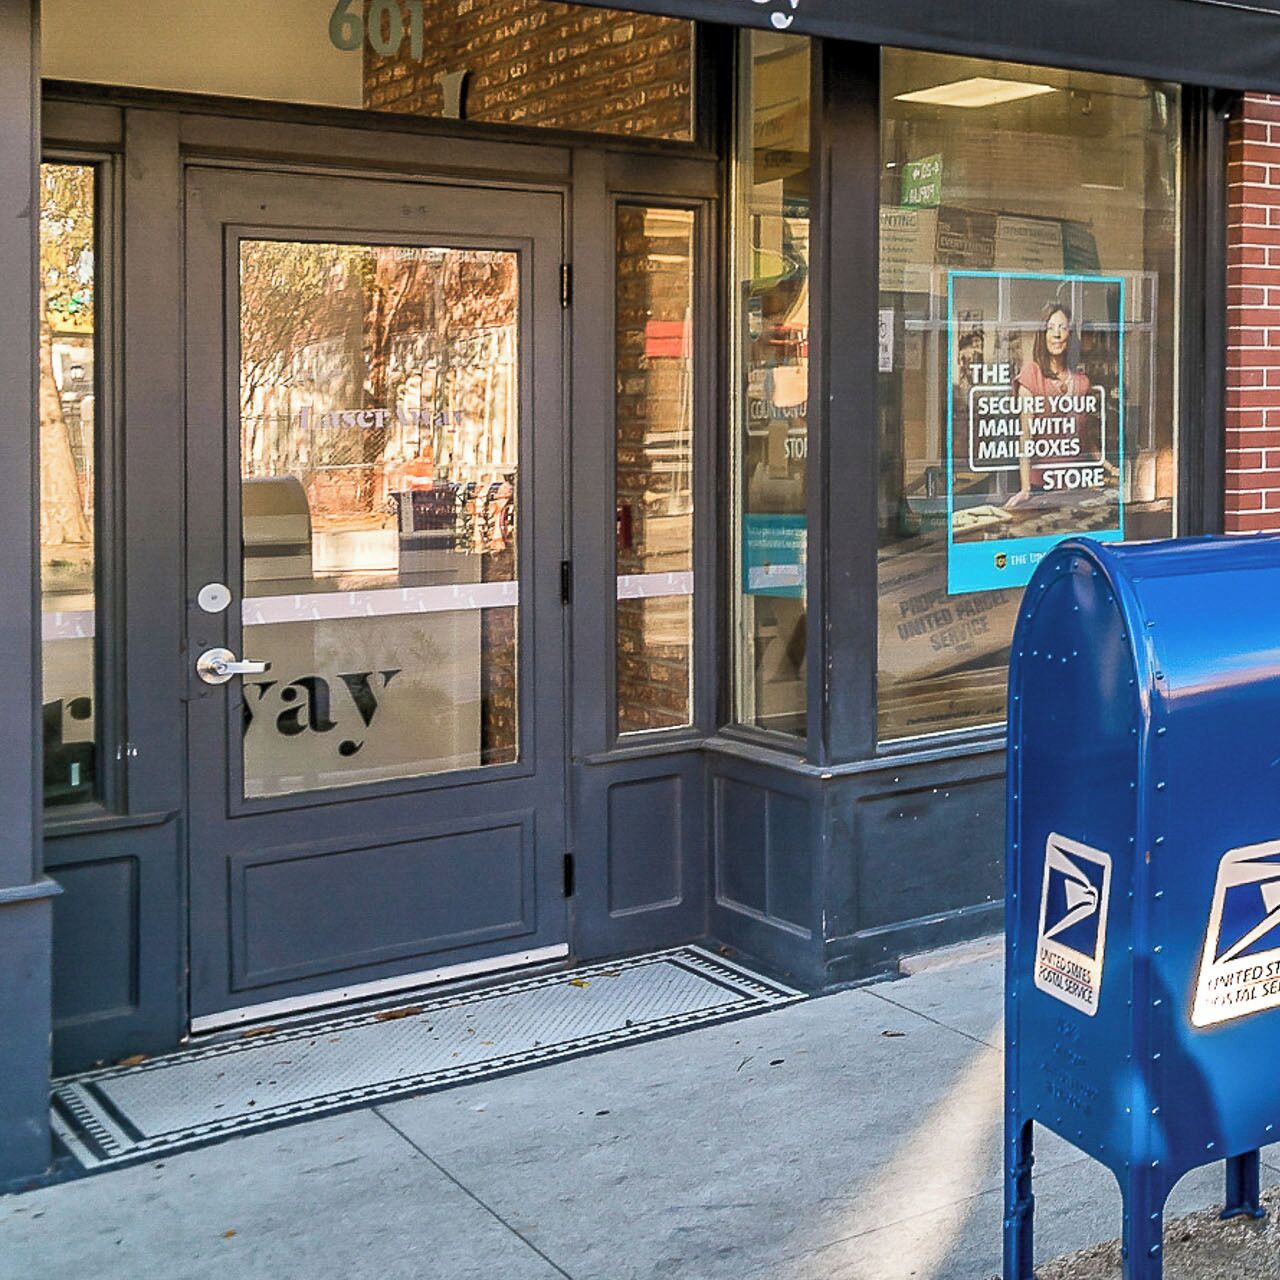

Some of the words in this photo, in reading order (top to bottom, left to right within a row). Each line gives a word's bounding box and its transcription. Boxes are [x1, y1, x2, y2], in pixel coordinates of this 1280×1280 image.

[968, 363, 1012, 386] THE
[977, 394, 1046, 417] SECURE
[1048, 392, 1098, 415] YOUR
[977, 416, 1024, 439] MAIL
[1027, 415, 1076, 438] WITH
[977, 437, 1081, 460] MAILBOXES
[1042, 467, 1105, 491] STORE
[1010, 554, 1027, 566] THE
[1039, 946, 1066, 973] UNITED
[1066, 959, 1093, 984] STATES
[1206, 965, 1265, 992] UNITED
[1064, 978, 1093, 1005] SERVICE
